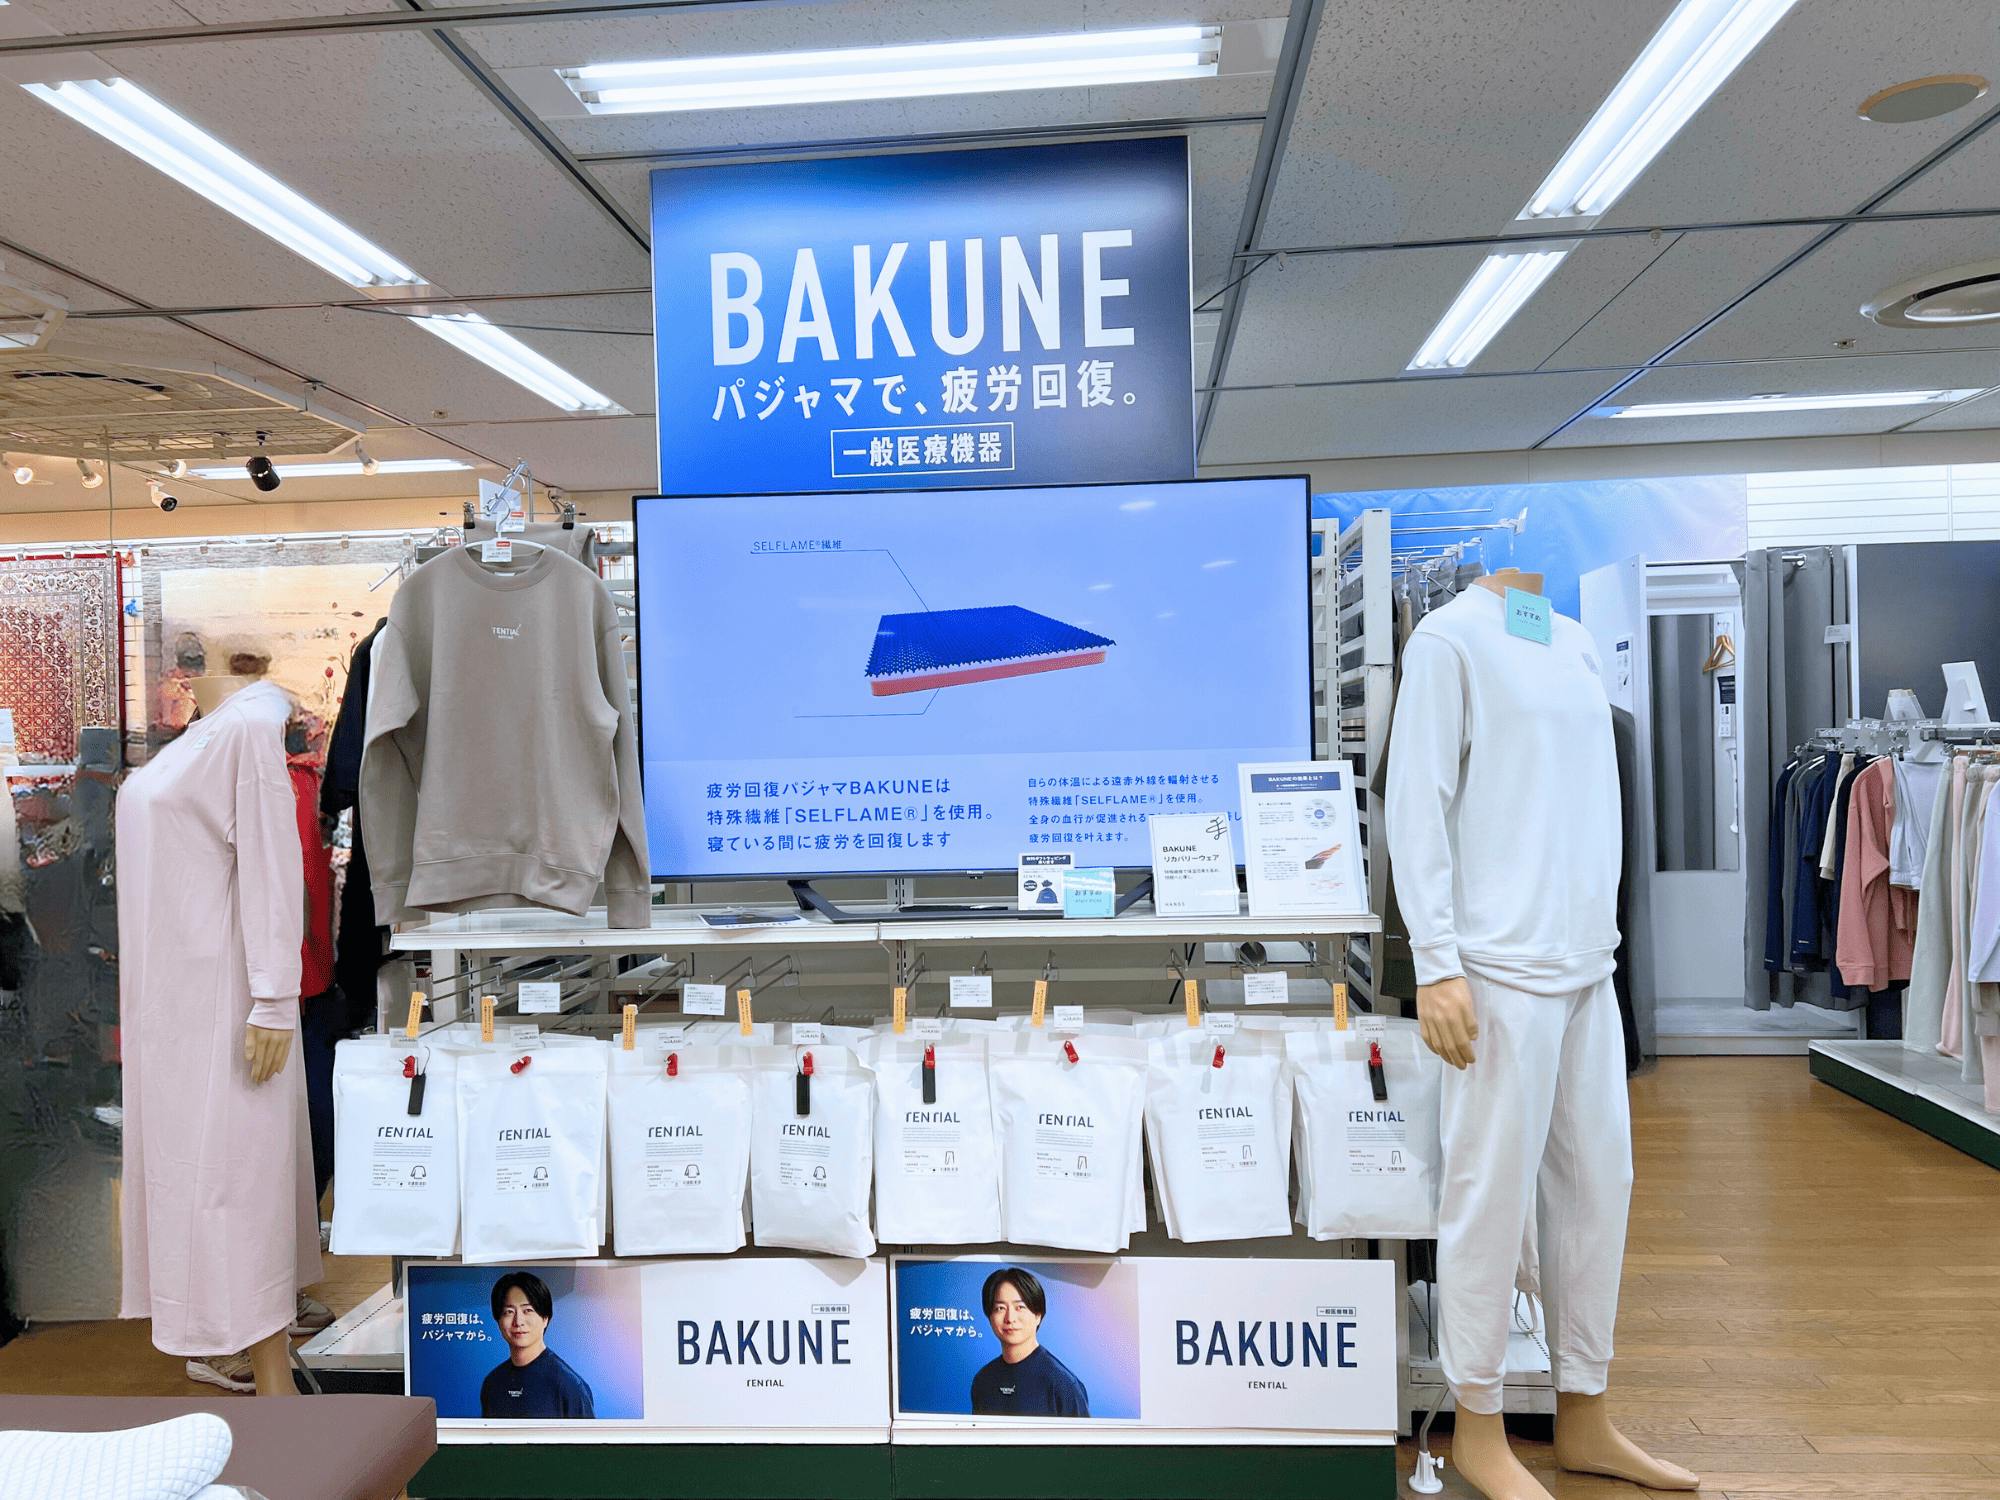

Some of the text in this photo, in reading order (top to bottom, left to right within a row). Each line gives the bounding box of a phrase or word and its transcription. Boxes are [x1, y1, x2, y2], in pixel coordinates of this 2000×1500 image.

[710, 230, 1135, 366] BAKUNE
[712, 360, 1136, 421] パジャマで、疲労回復。
[843, 431, 1002, 467] 一般医療機器
[706, 778, 951, 799] 疲労回復パジャマBAKUNEは
[1028, 774, 1219, 788] 自らの体温による遠赤外線を輻射させる
[707, 831, 951, 852] 寝ている間に疲労を回復します
[1029, 831, 1128, 844] 疲労回復を叶えます。
[1164, 854, 1219, 863] リカバリーウェア
[421, 1313, 484, 1325] 疲労回復は、
[910, 1307, 975, 1320] 疲労回復は、
[422, 1329, 492, 1341] パジャマから。
[910, 1324, 983, 1338] パジャマから。
[677, 1319, 851, 1365] BAKUNE
[1176, 1320, 1358, 1368] BAKUNE
